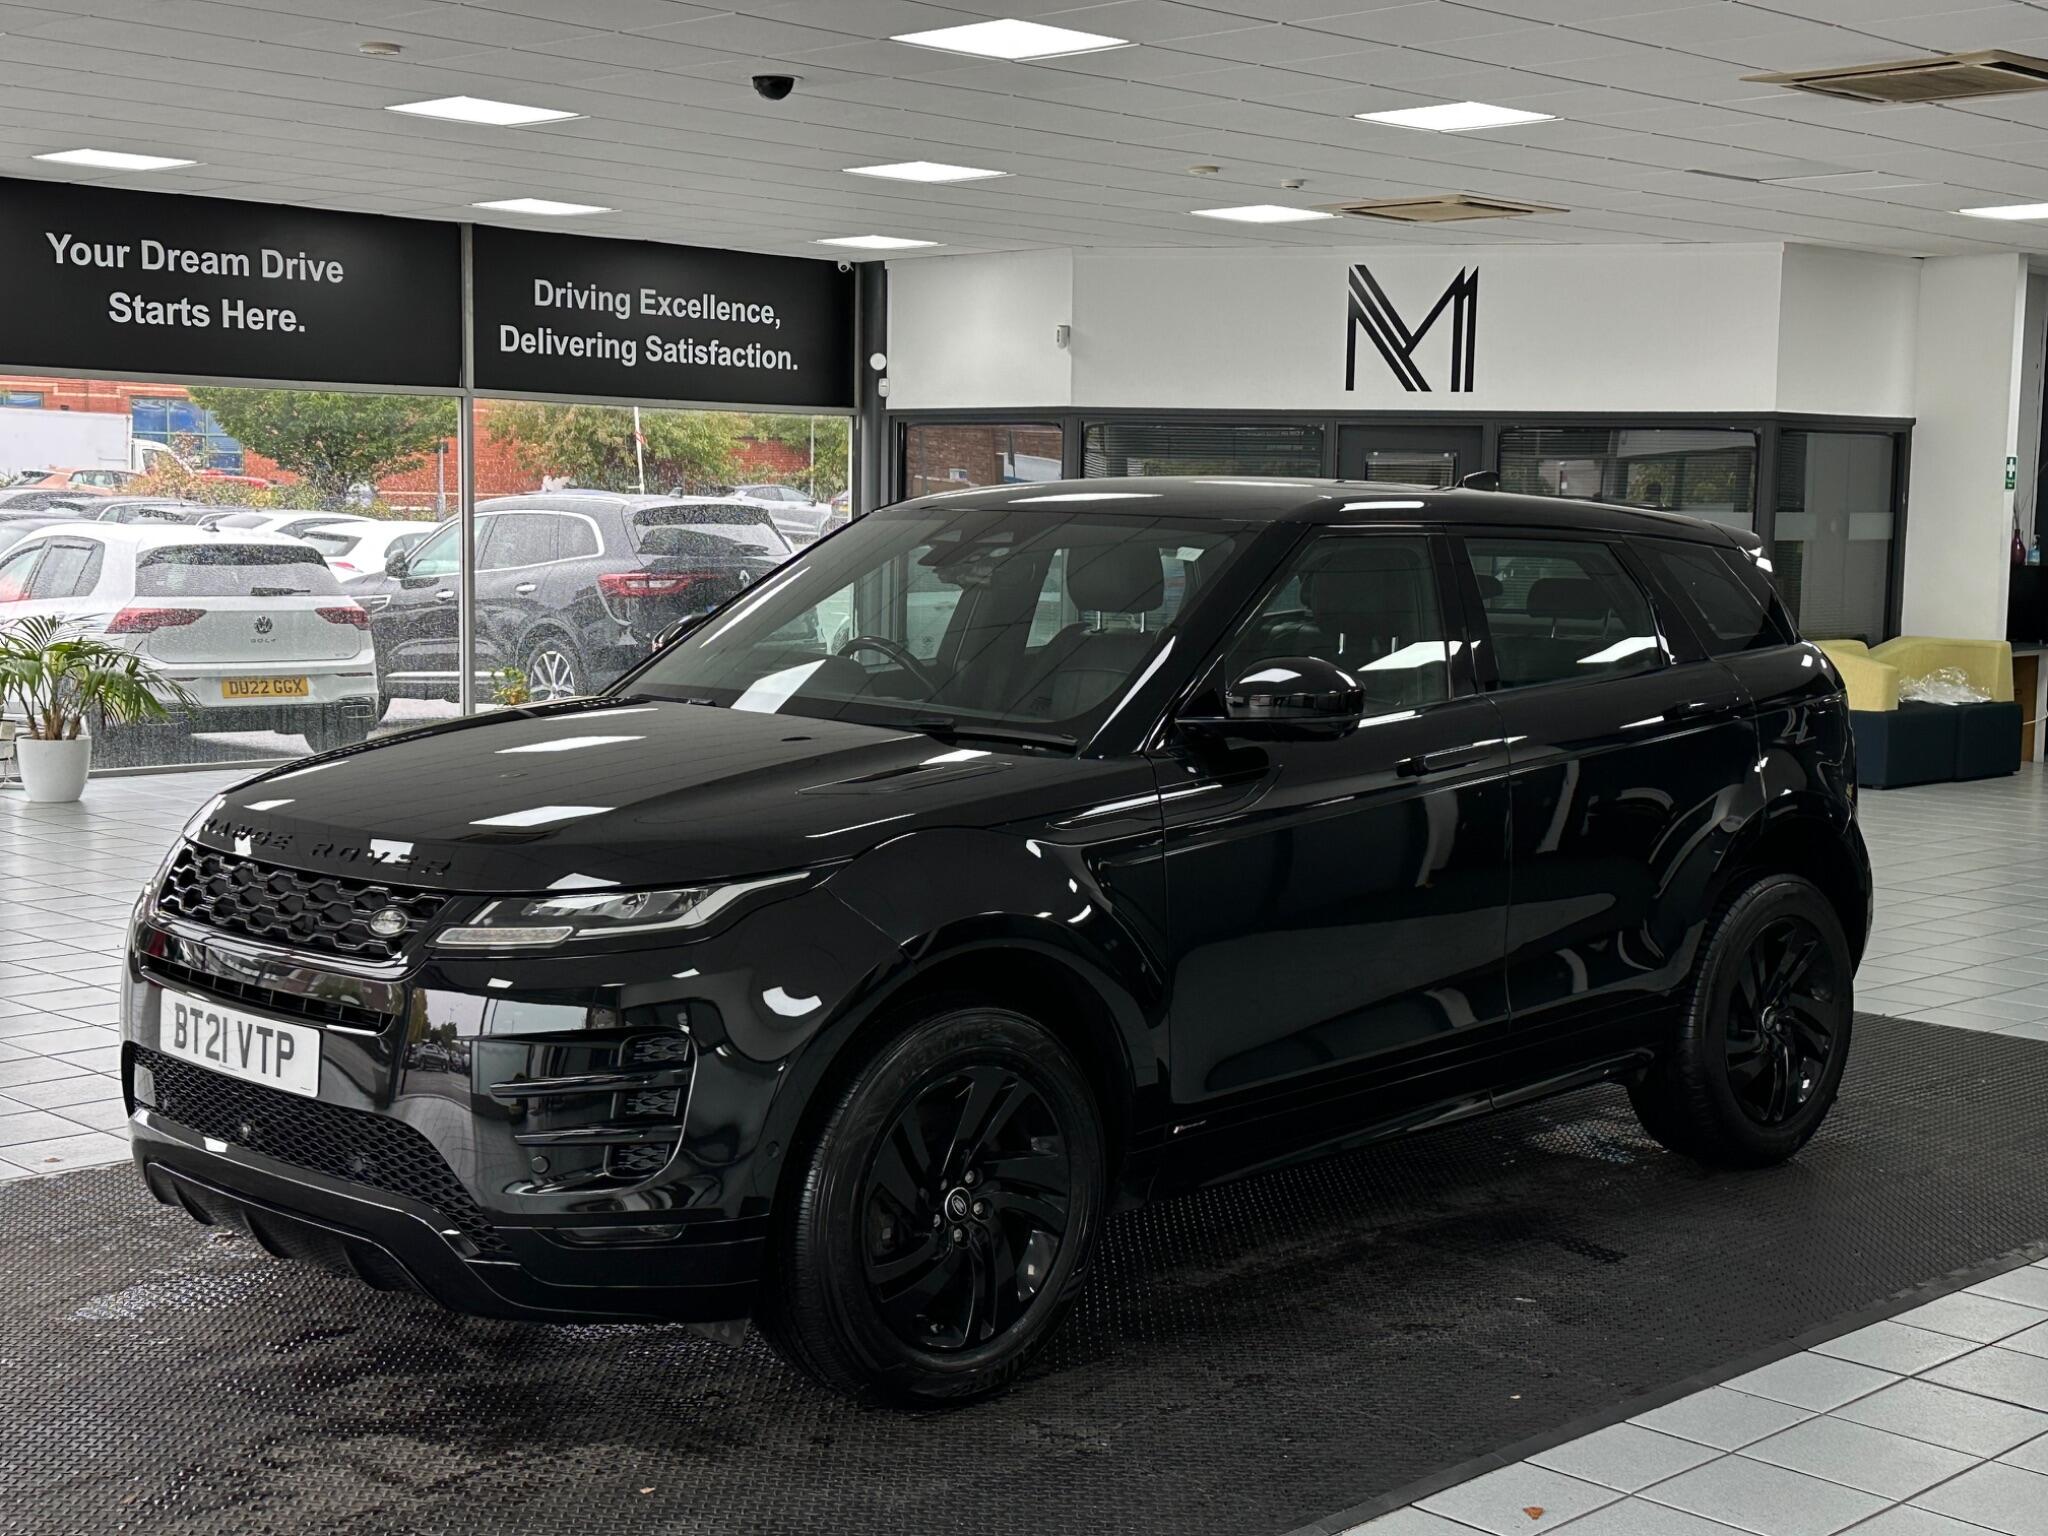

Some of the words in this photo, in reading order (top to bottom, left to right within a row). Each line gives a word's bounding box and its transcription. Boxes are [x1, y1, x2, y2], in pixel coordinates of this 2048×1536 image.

[46, 232, 130, 267] Your
[141, 240, 250, 277] Dream
[261, 249, 344, 283] Drive
[108, 291, 210, 328] Starts
[222, 299, 306, 332] Here.
[534, 279, 631, 319] Driving
[640, 288, 781, 329] Excellence,
[500, 325, 637, 367] Delivering
[645, 335, 799, 371] Satisfaction.
[229, 679, 270, 695] DU22
[273, 678, 303, 694] GGX
[310, 843, 453, 876] ROVER
[174, 1002, 228, 1063] BT21
[237, 1020, 295, 1078] VTP
